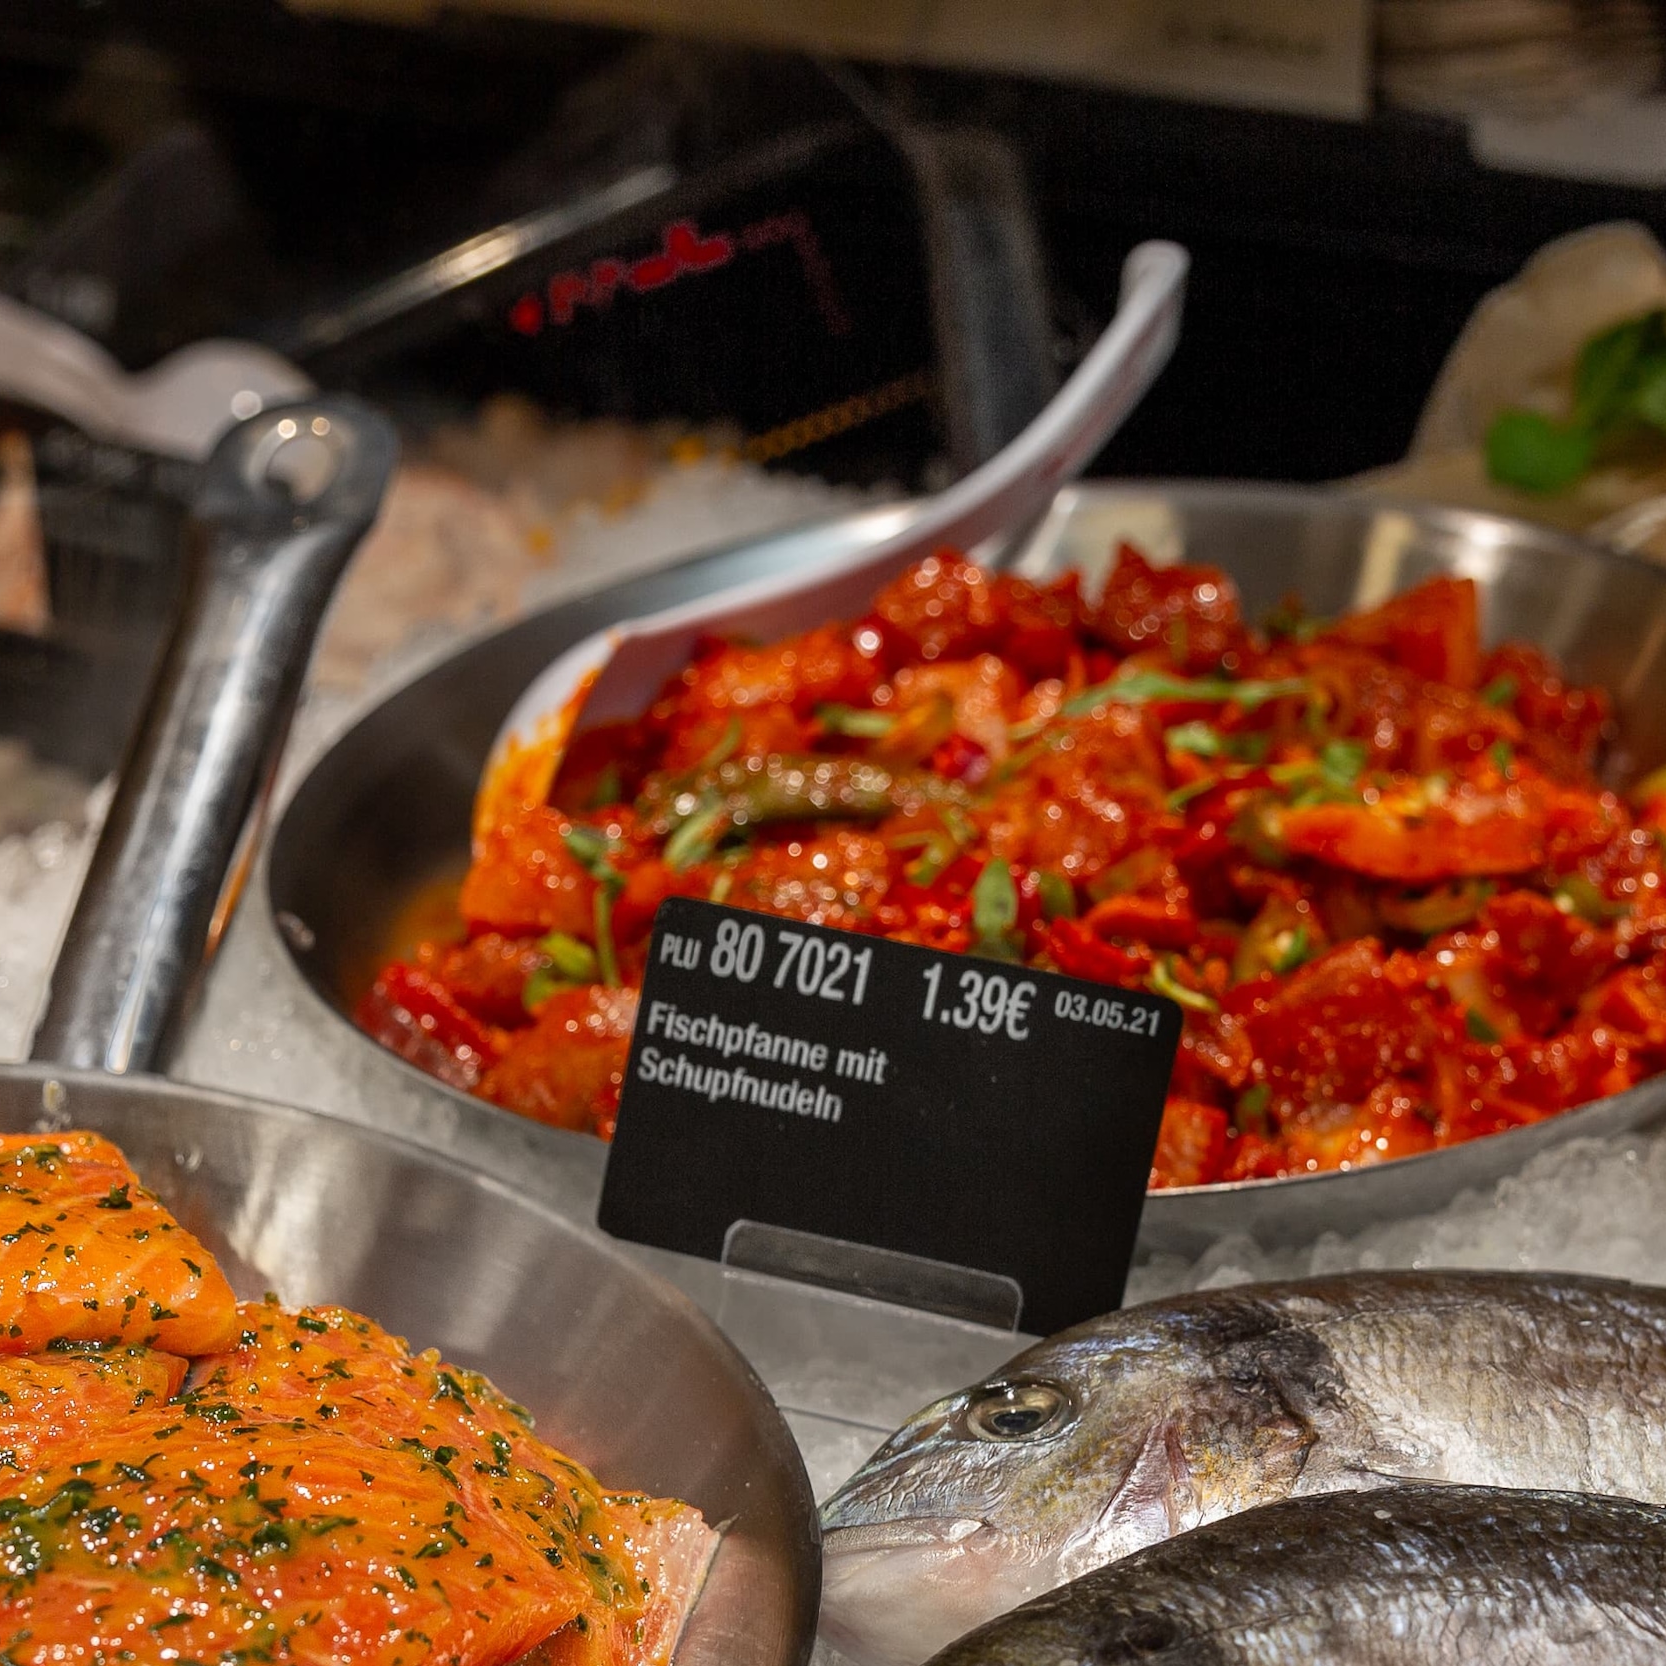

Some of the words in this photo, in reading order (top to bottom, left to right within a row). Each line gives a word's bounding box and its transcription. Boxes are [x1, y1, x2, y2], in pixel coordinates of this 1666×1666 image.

[659, 932, 702, 970] PLU
[709, 918, 765, 983] 80
[773, 930, 873, 1005] 7021
[922, 962, 1037, 1041] 1.39€
[1054, 990, 1160, 1037] 03.05.21
[637, 1046, 842, 1122] Schupfnudeln
[646, 1000, 829, 1072] Fischpfanne
[835, 1047, 889, 1085] mit
